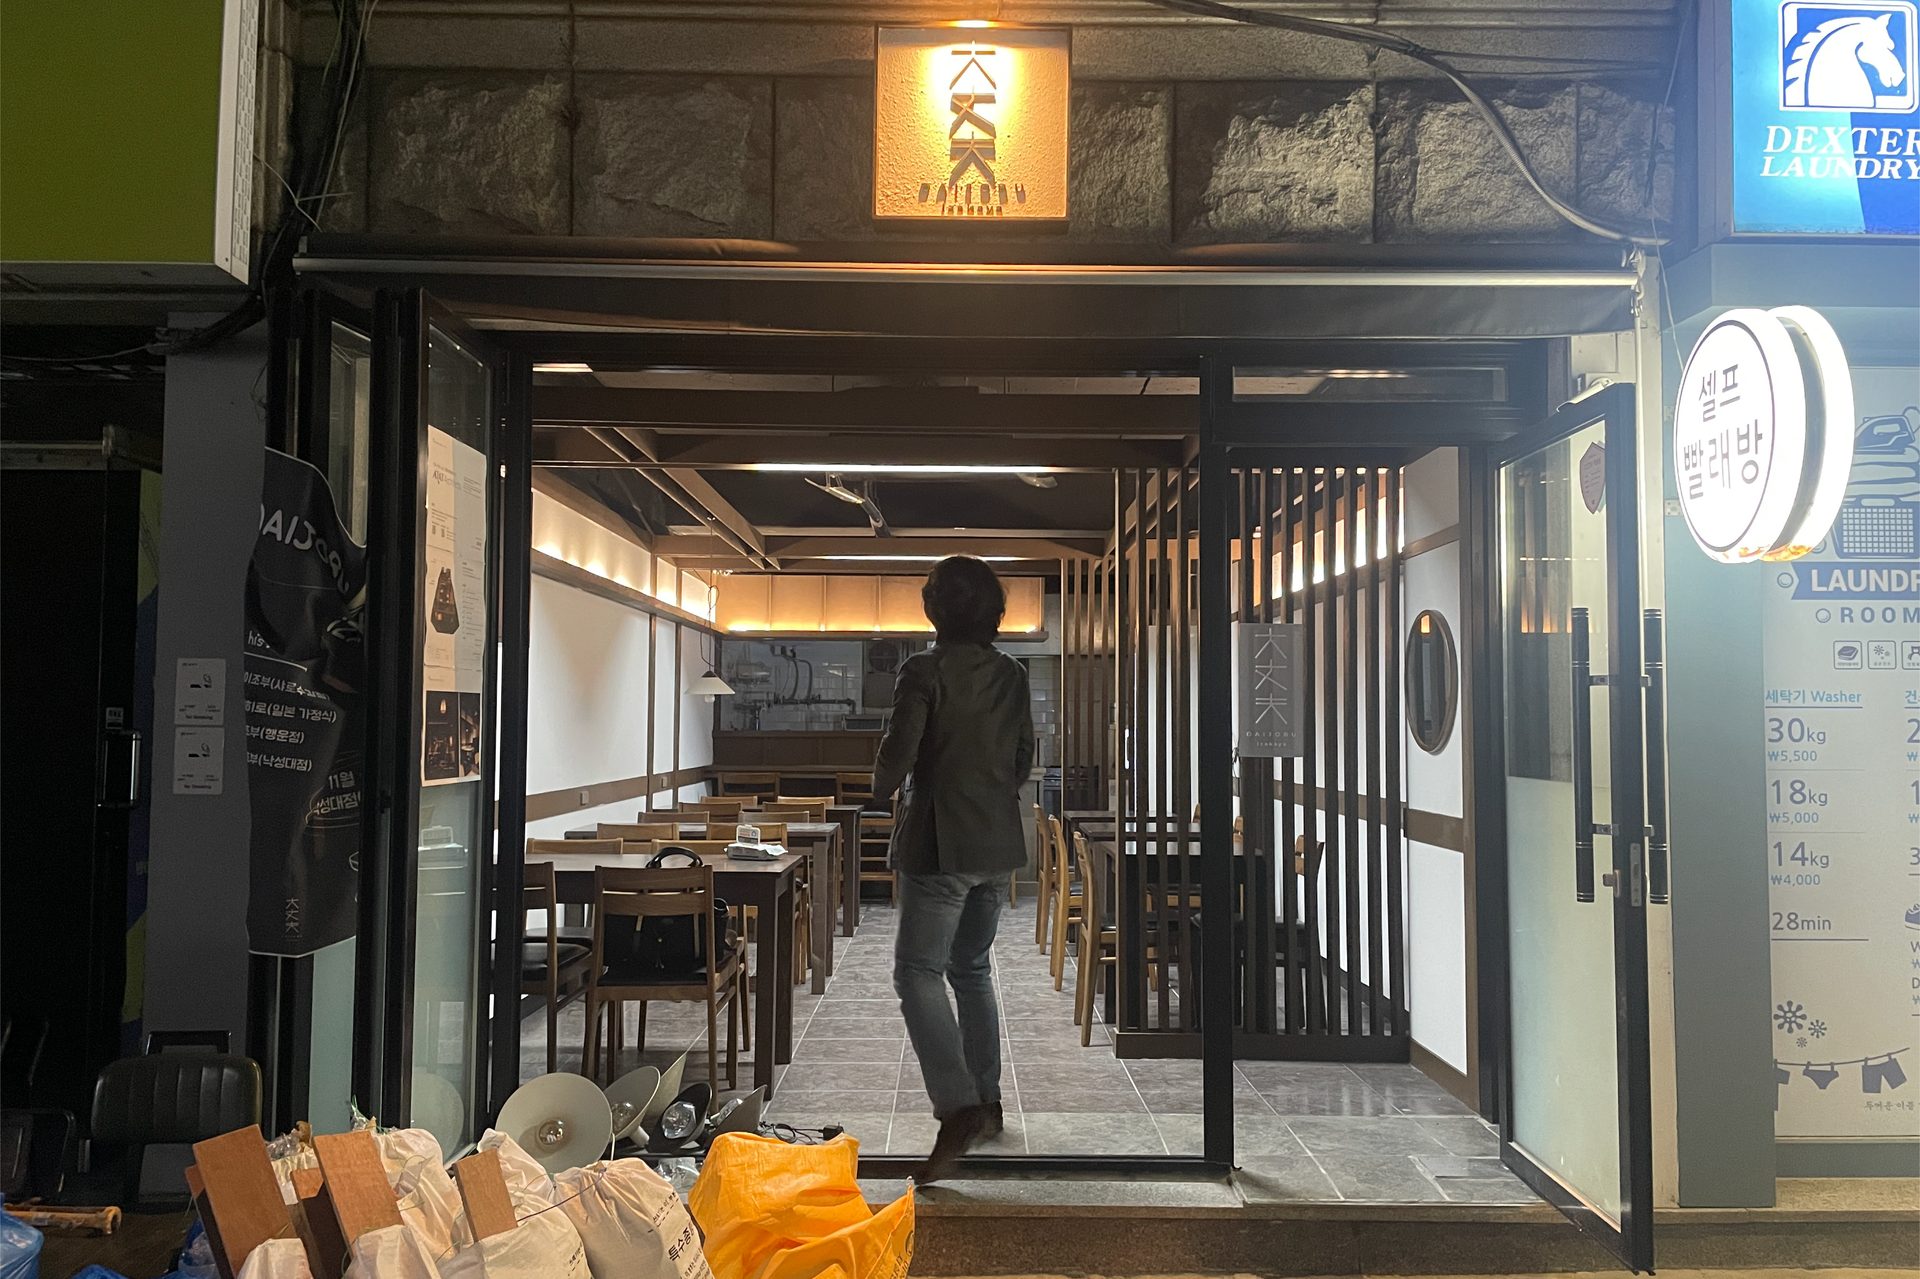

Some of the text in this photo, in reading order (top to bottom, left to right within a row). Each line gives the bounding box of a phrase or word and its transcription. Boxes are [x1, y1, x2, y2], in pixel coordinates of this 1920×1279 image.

[1763, 125, 1920, 156] DEXTER
[1760, 156, 1920, 179] LAUNDRY
[1698, 363, 1741, 423] 셀프
[1683, 418, 1763, 500] 빨래방
[1840, 607, 1920, 624] ROOM
[1254, 627, 1288, 725] 大丈夫
[1765, 689, 1862, 704] 세탁기 Washer
[1768, 717, 1826, 744] 30kg
[1771, 779, 1828, 807] 18kg
[1772, 841, 1830, 868] 14kg
[1772, 911, 1832, 931] 28min
